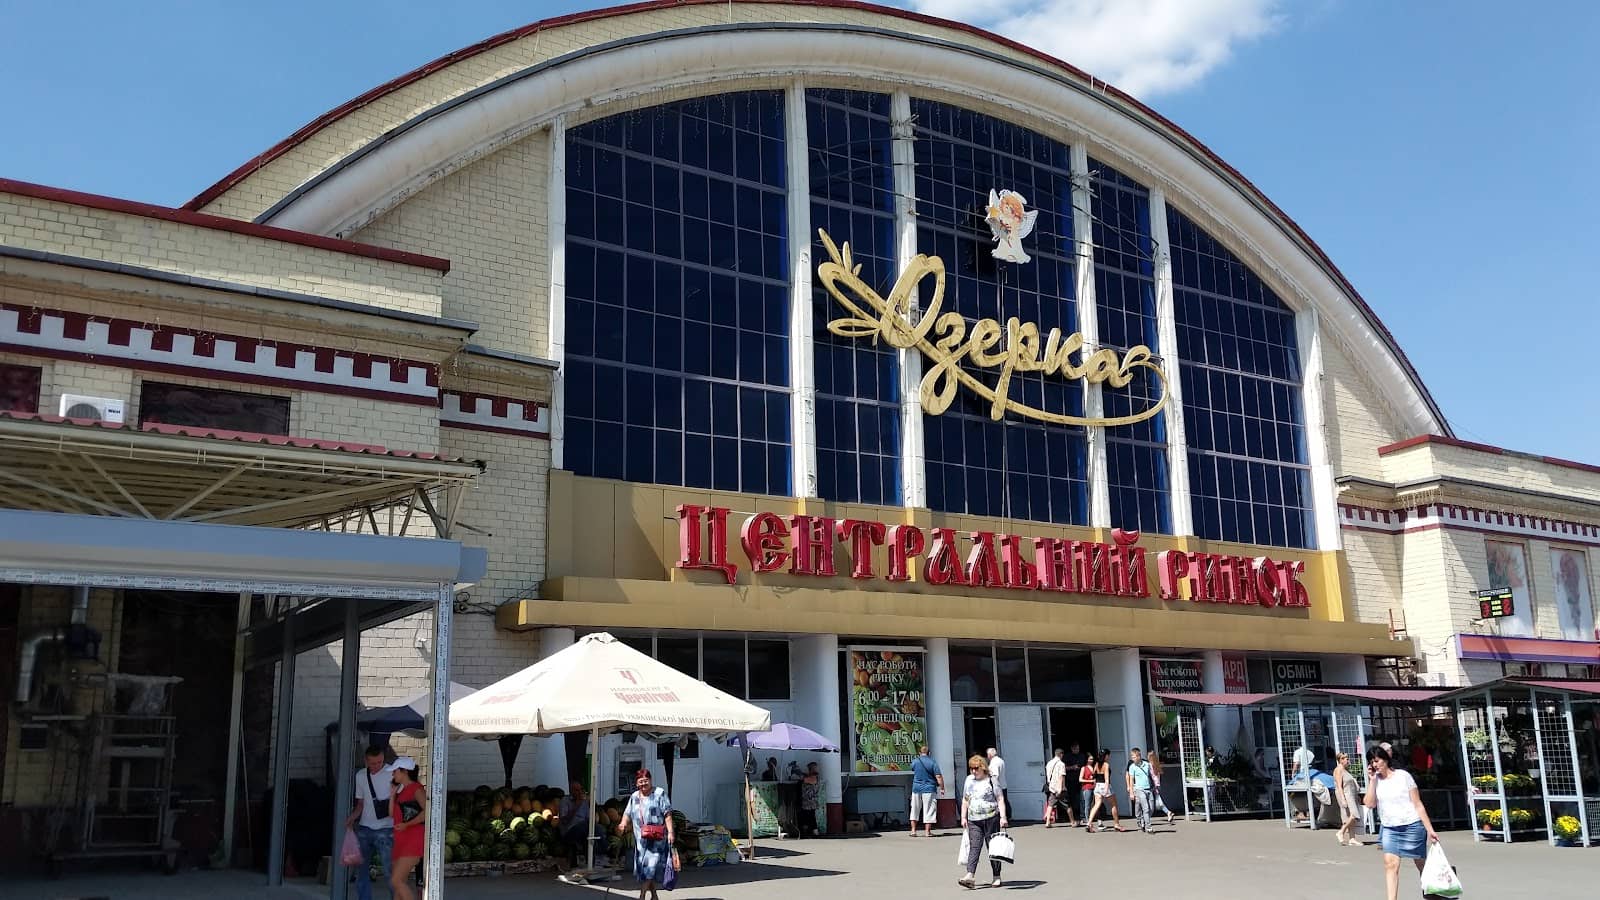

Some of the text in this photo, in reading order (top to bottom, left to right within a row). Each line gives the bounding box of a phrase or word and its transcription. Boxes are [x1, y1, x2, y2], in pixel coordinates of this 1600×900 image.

[818, 228, 1170, 425] Озерка
[675, 503, 1312, 608] ЦЕНТРАЛЬНИЙ РИНОК
[880, 660, 917, 670] РОБОТИ
[1276, 664, 1317, 679] ОБМІН
[872, 673, 904, 684] РИНКУ
